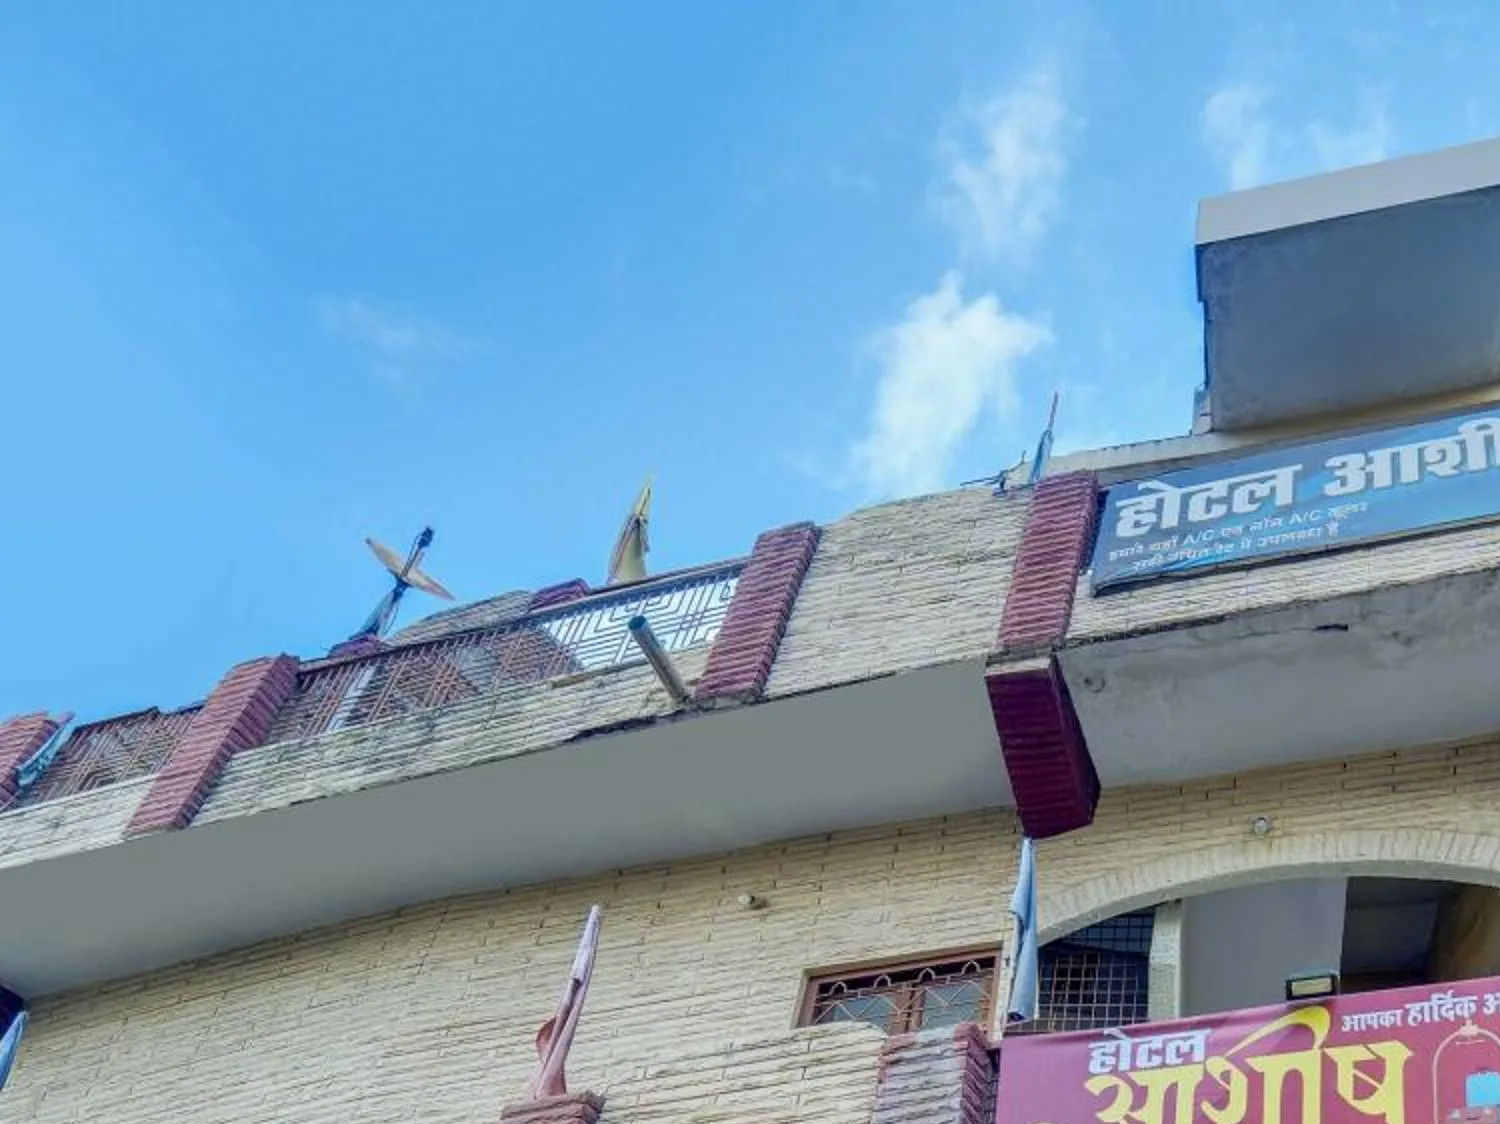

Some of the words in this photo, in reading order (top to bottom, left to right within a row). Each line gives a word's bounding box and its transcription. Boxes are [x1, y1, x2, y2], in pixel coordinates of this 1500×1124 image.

[1114, 463, 1301, 538] होटल
[1183, 528, 1215, 546] A/C
[1289, 508, 1321, 525] A/C
[1341, 1009, 1404, 1032] आपका
[1405, 990, 1478, 1026] हार्दिक
[1088, 1027, 1211, 1074] होटल
